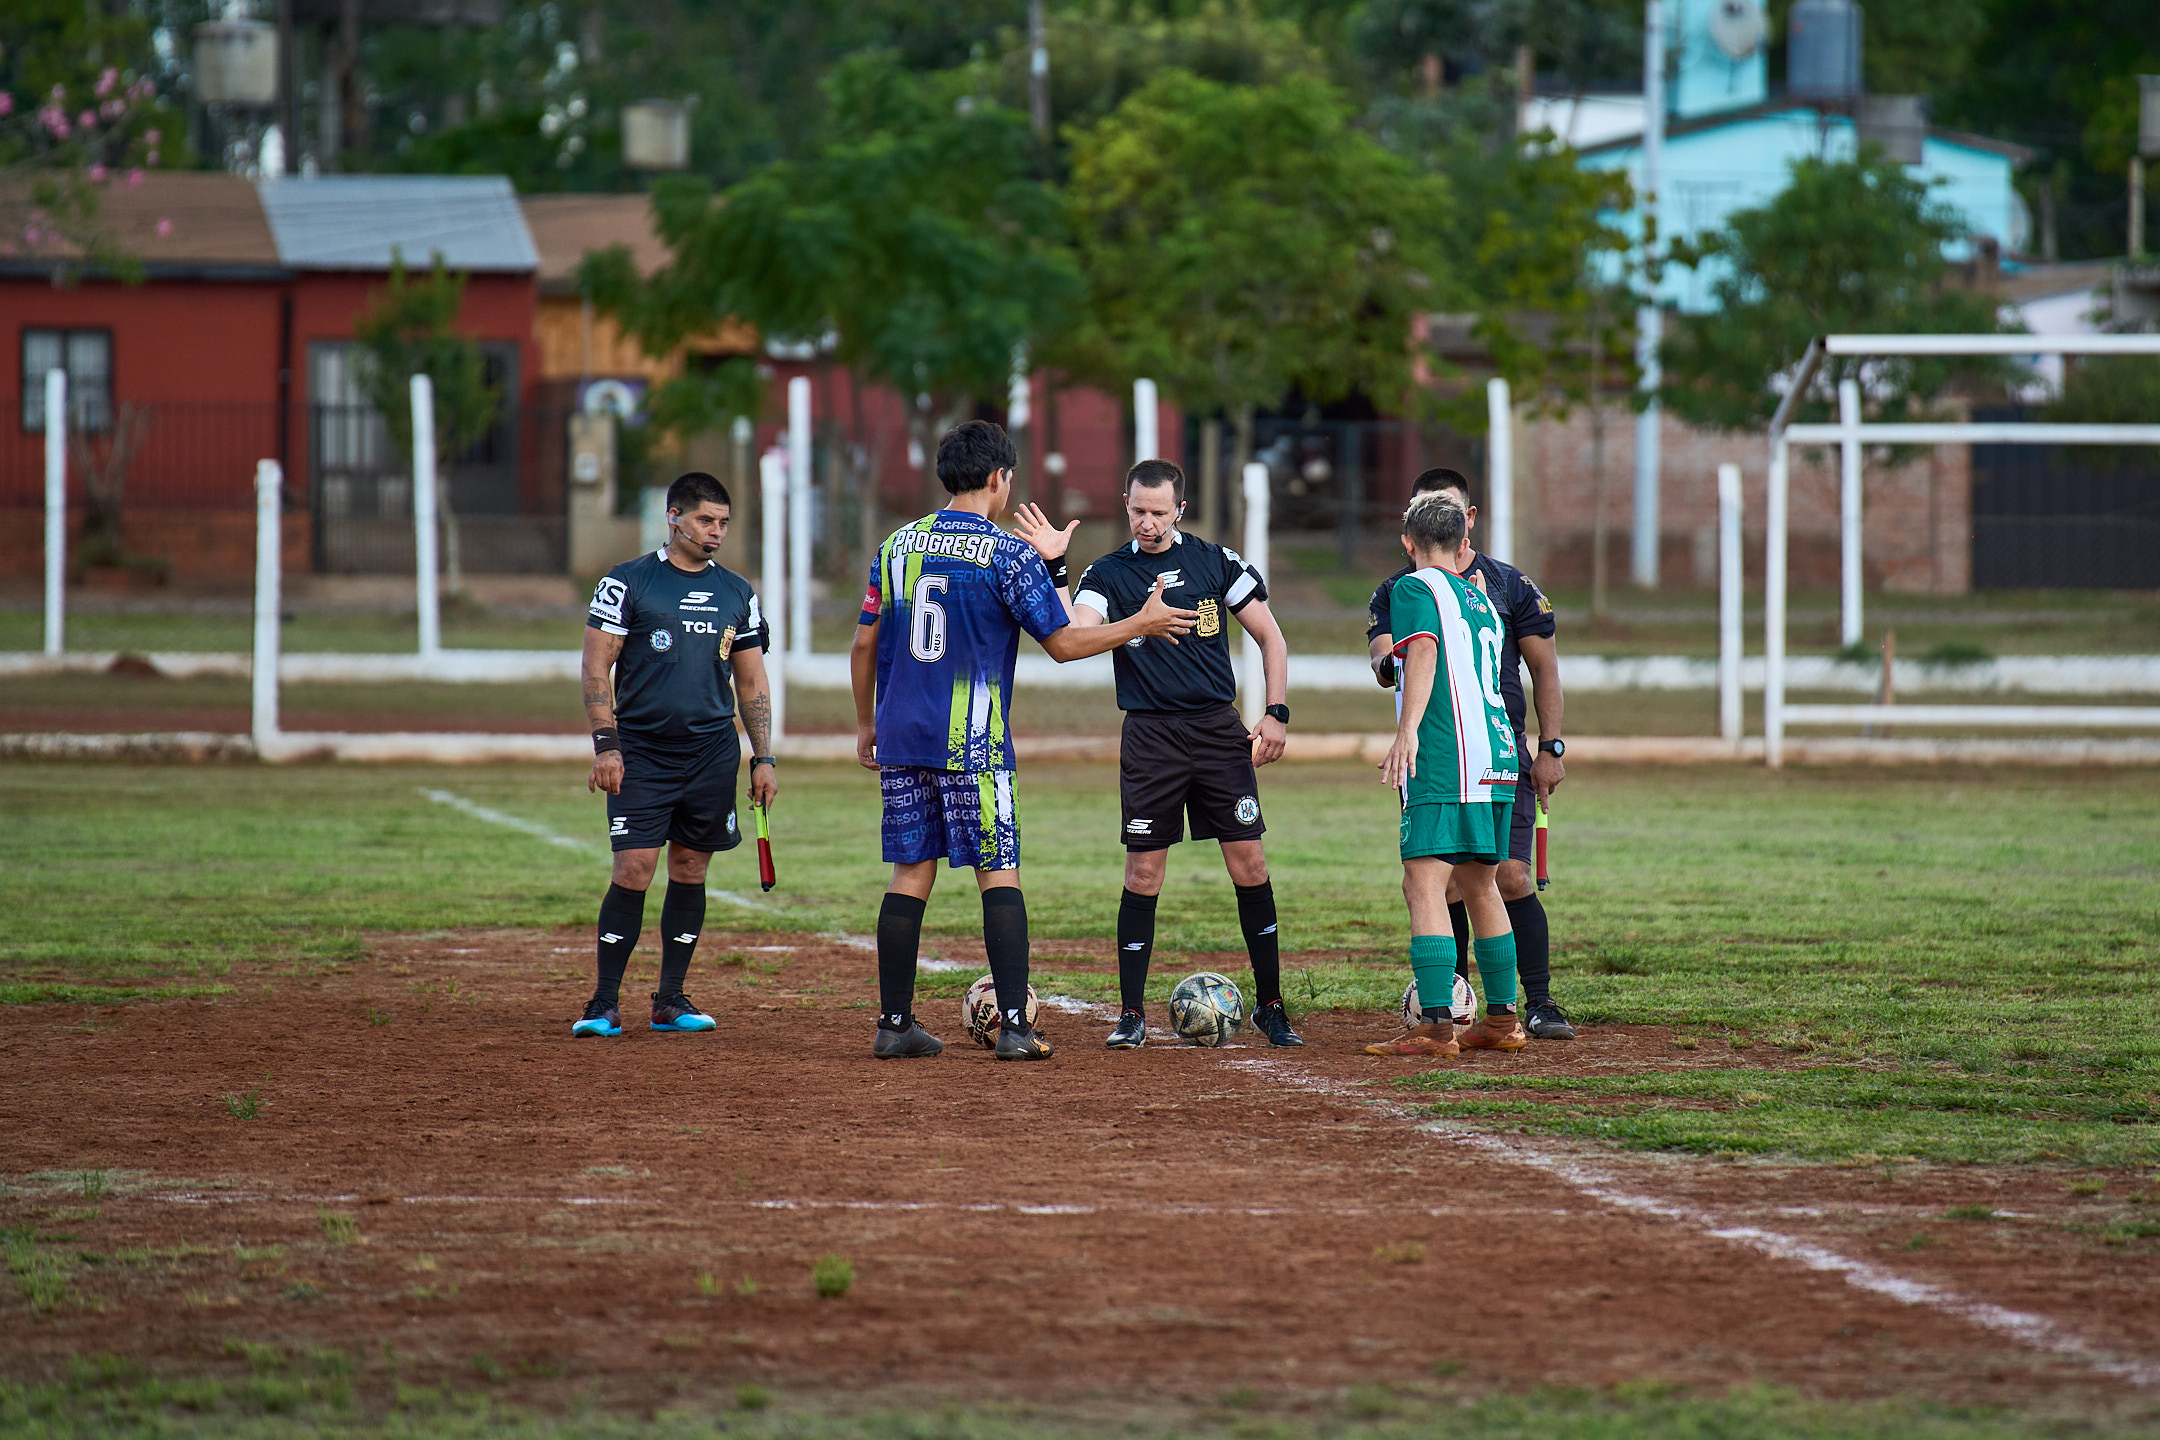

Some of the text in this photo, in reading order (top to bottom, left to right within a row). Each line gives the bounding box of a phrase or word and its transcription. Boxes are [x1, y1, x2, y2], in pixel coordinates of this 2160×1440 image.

[890, 530, 997, 568] PROGRESO
[682, 620, 718, 634] TCL
[910, 574, 948, 662] 6
